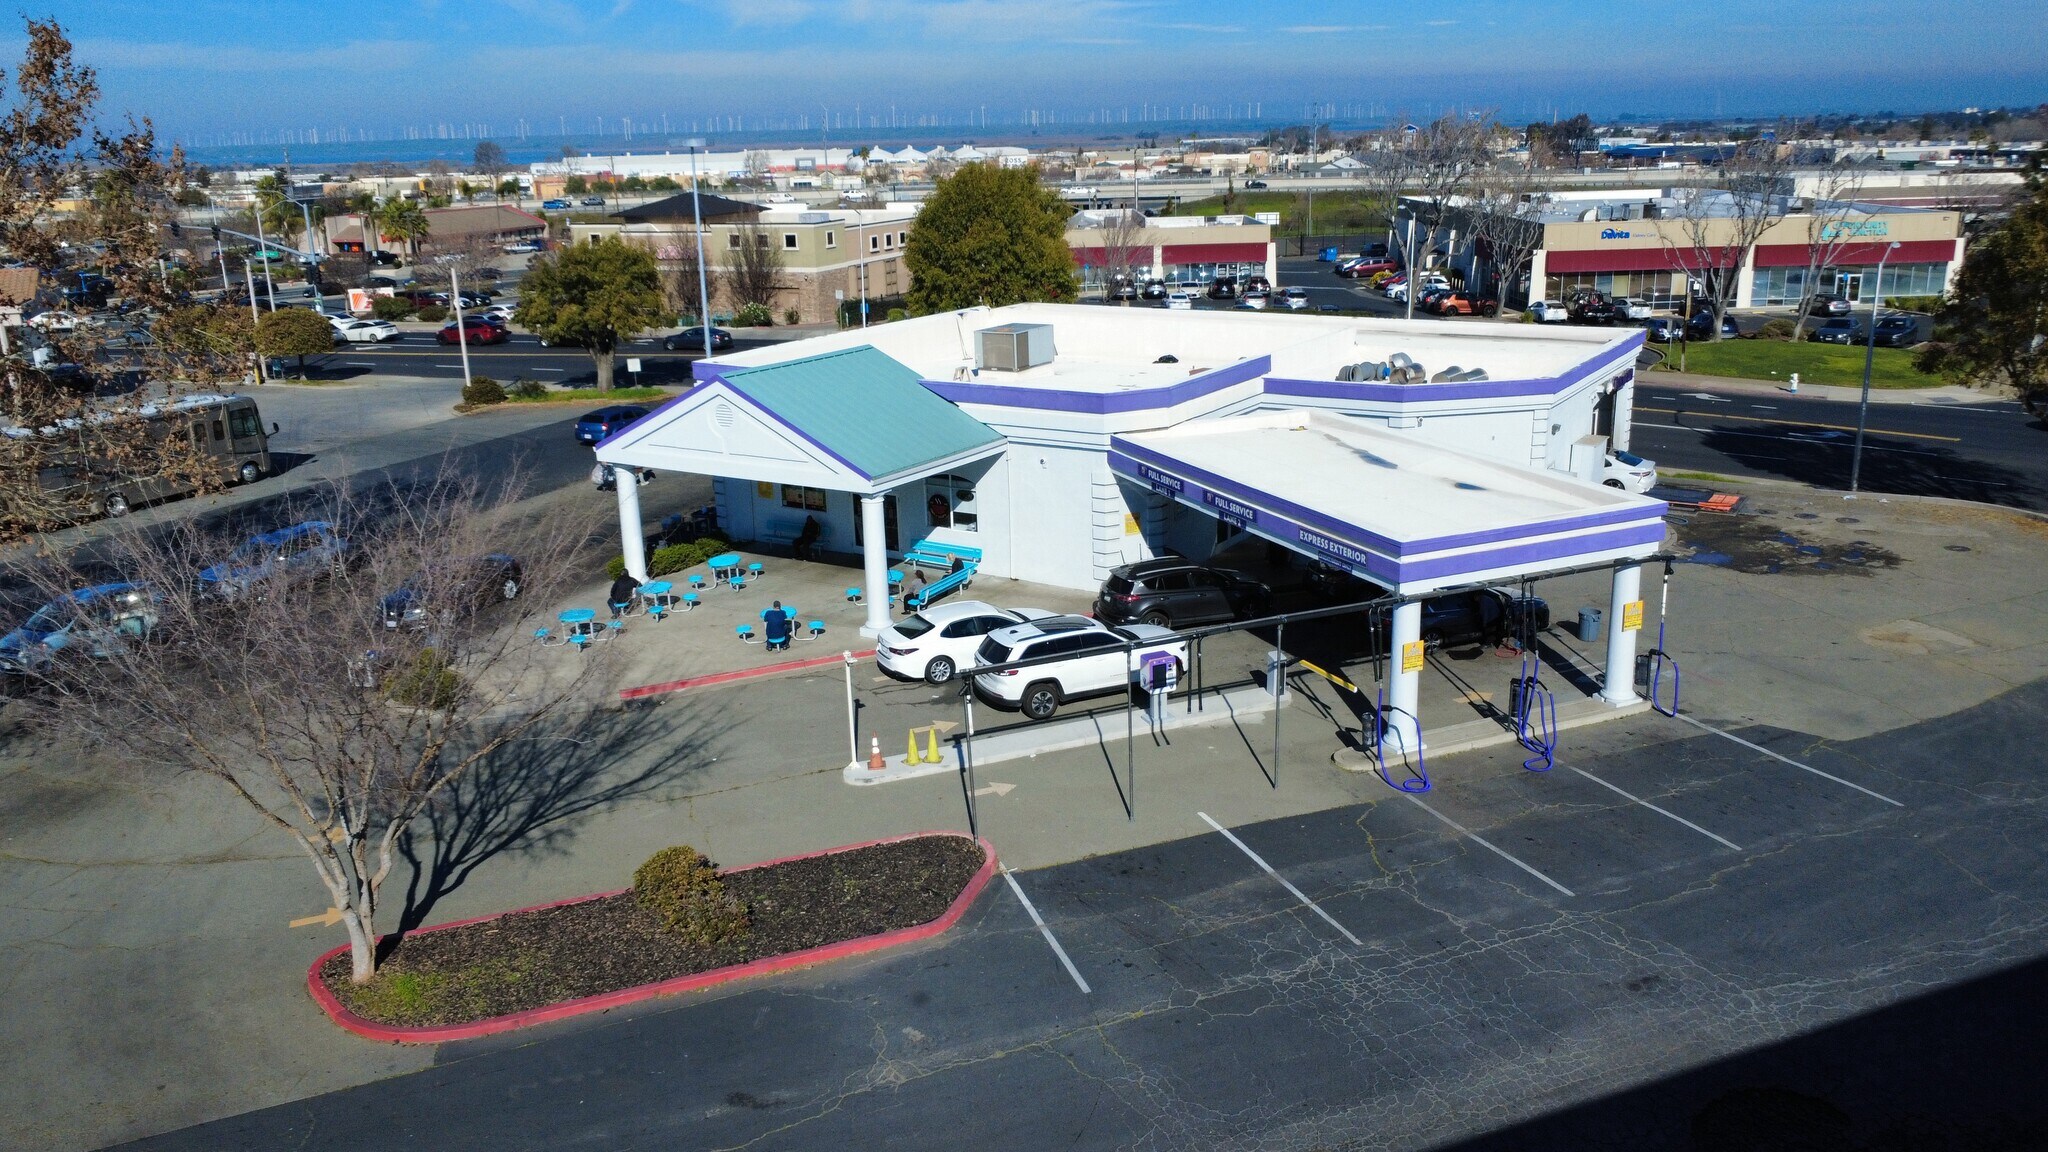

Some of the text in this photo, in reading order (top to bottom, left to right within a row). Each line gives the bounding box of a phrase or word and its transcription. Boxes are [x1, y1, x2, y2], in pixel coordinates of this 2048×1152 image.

[1601, 228, 1630, 239] DaVita
[1148, 470, 1181, 489] FULL SERVICE
[1215, 497, 1253, 519] FULL SERVICE
[1223, 513, 1237, 525] LANE
[1300, 530, 1328, 549] EXPRESS
[1329, 541, 1367, 564] EXTERIOR
